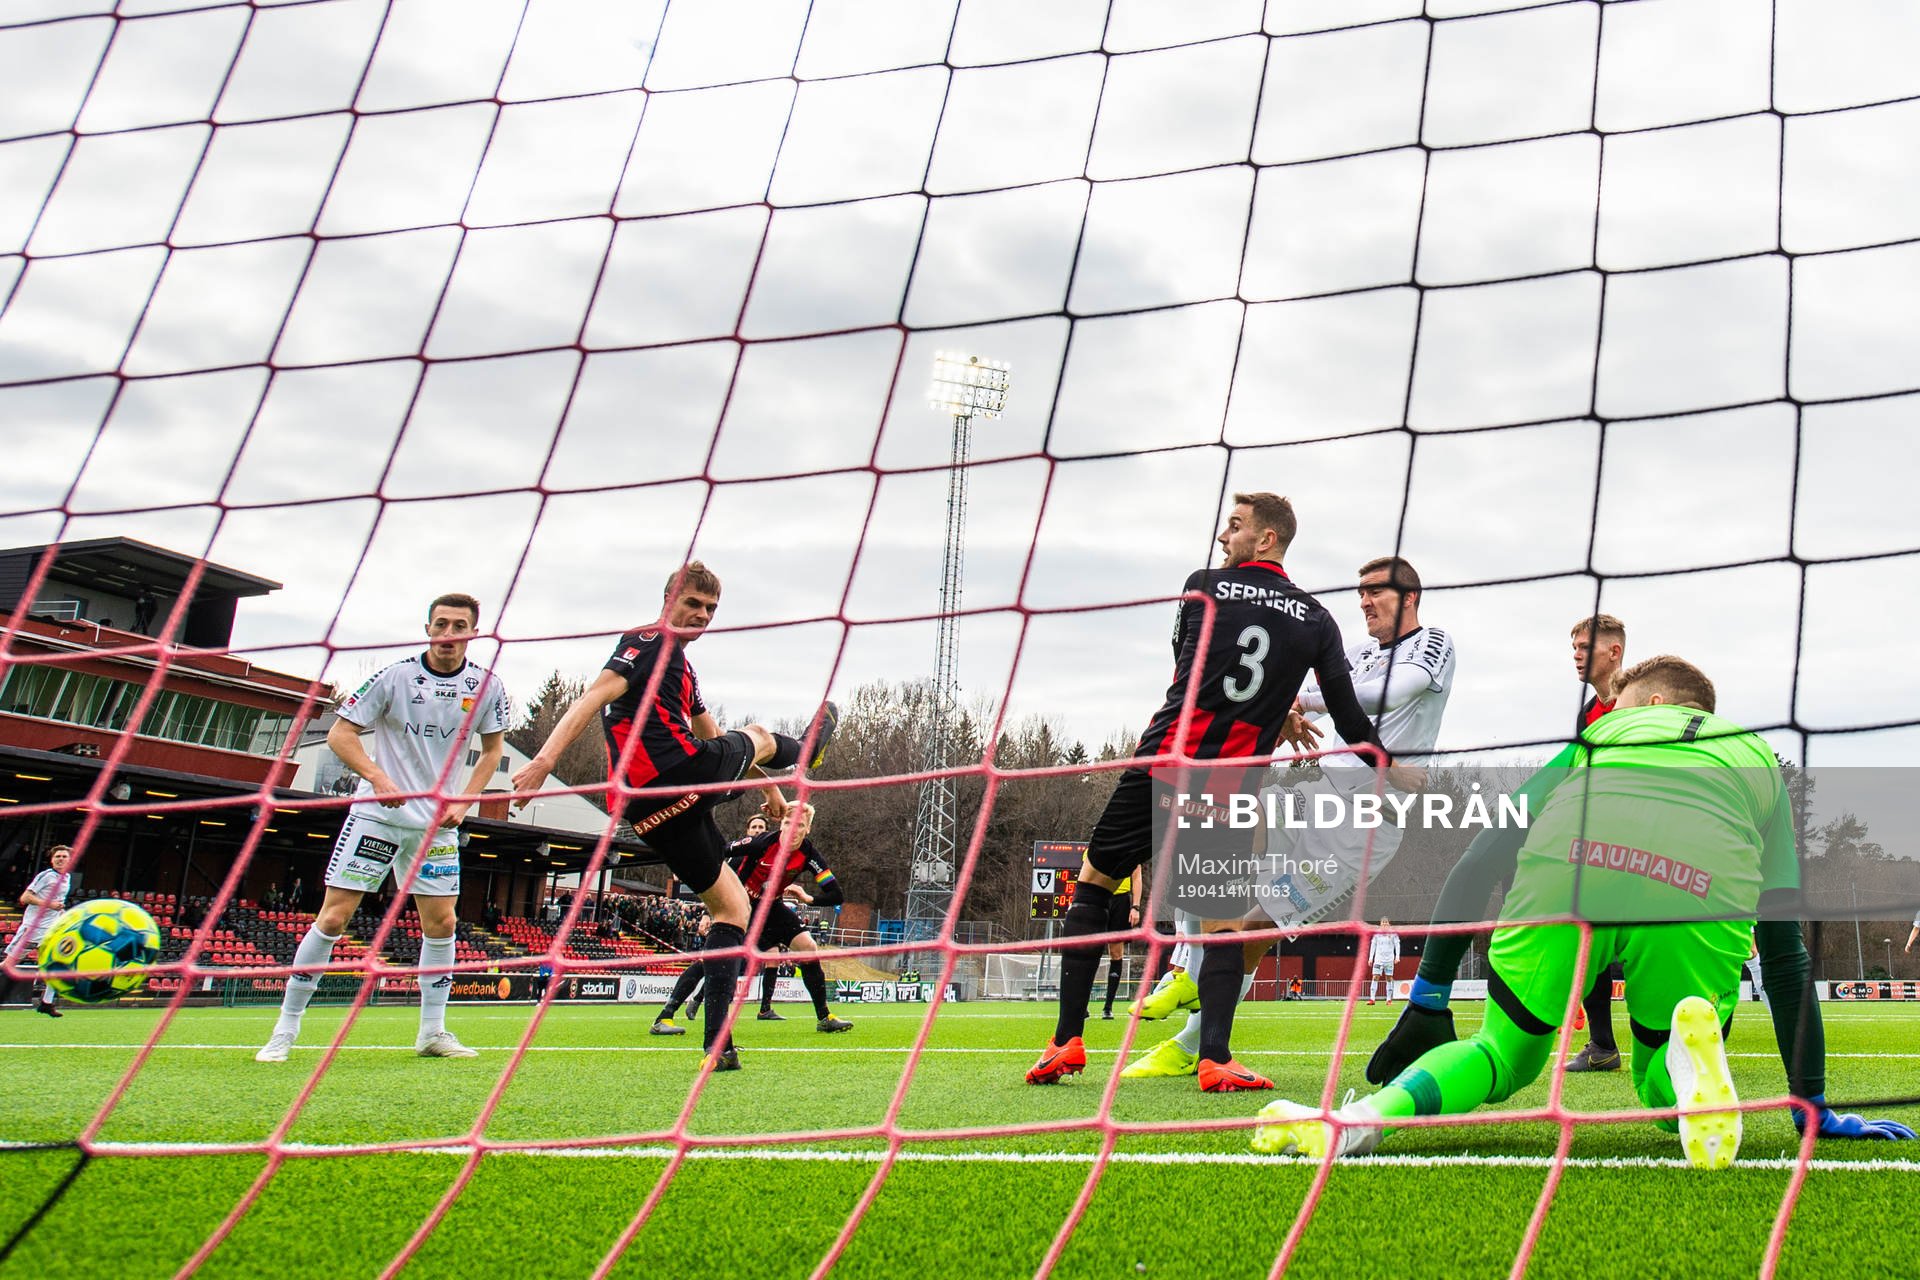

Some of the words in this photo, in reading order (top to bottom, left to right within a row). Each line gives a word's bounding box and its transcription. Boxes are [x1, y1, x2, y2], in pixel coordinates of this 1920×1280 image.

[1215, 581, 1309, 622] SERNEKE
[1222, 625, 1271, 703] 3
[634, 792, 699, 836] BAUHAUS
[363, 838, 394, 854] VIRTUAL
[1570, 841, 1711, 894] BAUHAUS
[450, 981, 497, 996] Swedbank
[581, 981, 615, 995] stadium
[640, 983, 674, 995] Volkswage
